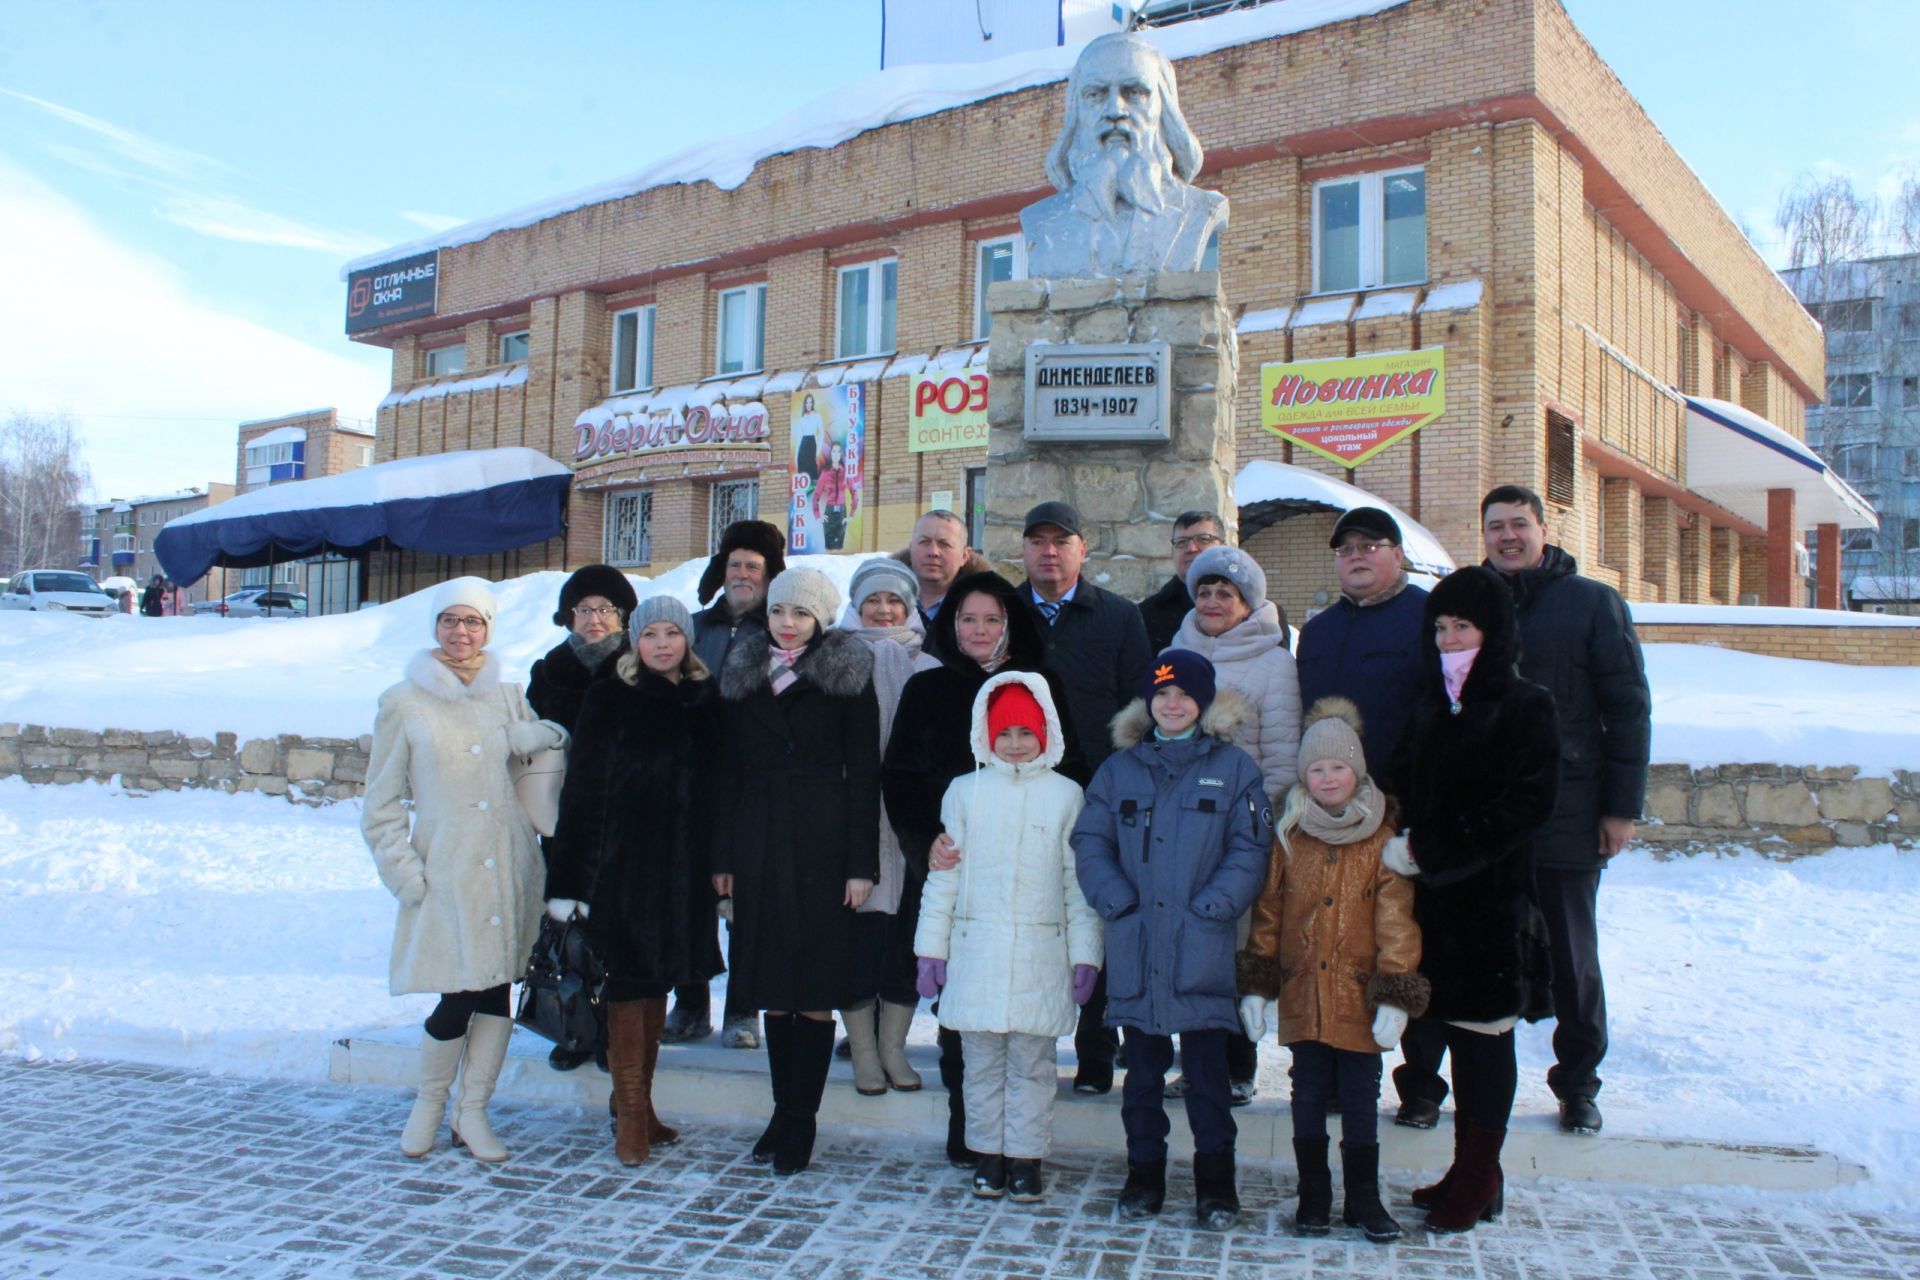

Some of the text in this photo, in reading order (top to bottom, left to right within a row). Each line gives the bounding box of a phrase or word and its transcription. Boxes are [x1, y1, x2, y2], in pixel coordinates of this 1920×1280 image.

[374, 263, 435, 290] ОТЛИЧНЫЕ
[373, 288, 402, 306] ОКНА
[1386, 357, 1431, 370] МАГАЗИН
[1271, 367, 1437, 408] Новинка
[1278, 410, 1323, 422] ОДЕЖДА
[1345, 403, 1376, 416] ВСЕЙ
[1379, 401, 1421, 413] СЕМЬИ
[846, 387, 859, 476] БЛУЗКИ
[1321, 430, 1378, 444] цокольный
[1336, 443, 1362, 452] этаж
[792, 475, 809, 548] ЮБКИ
